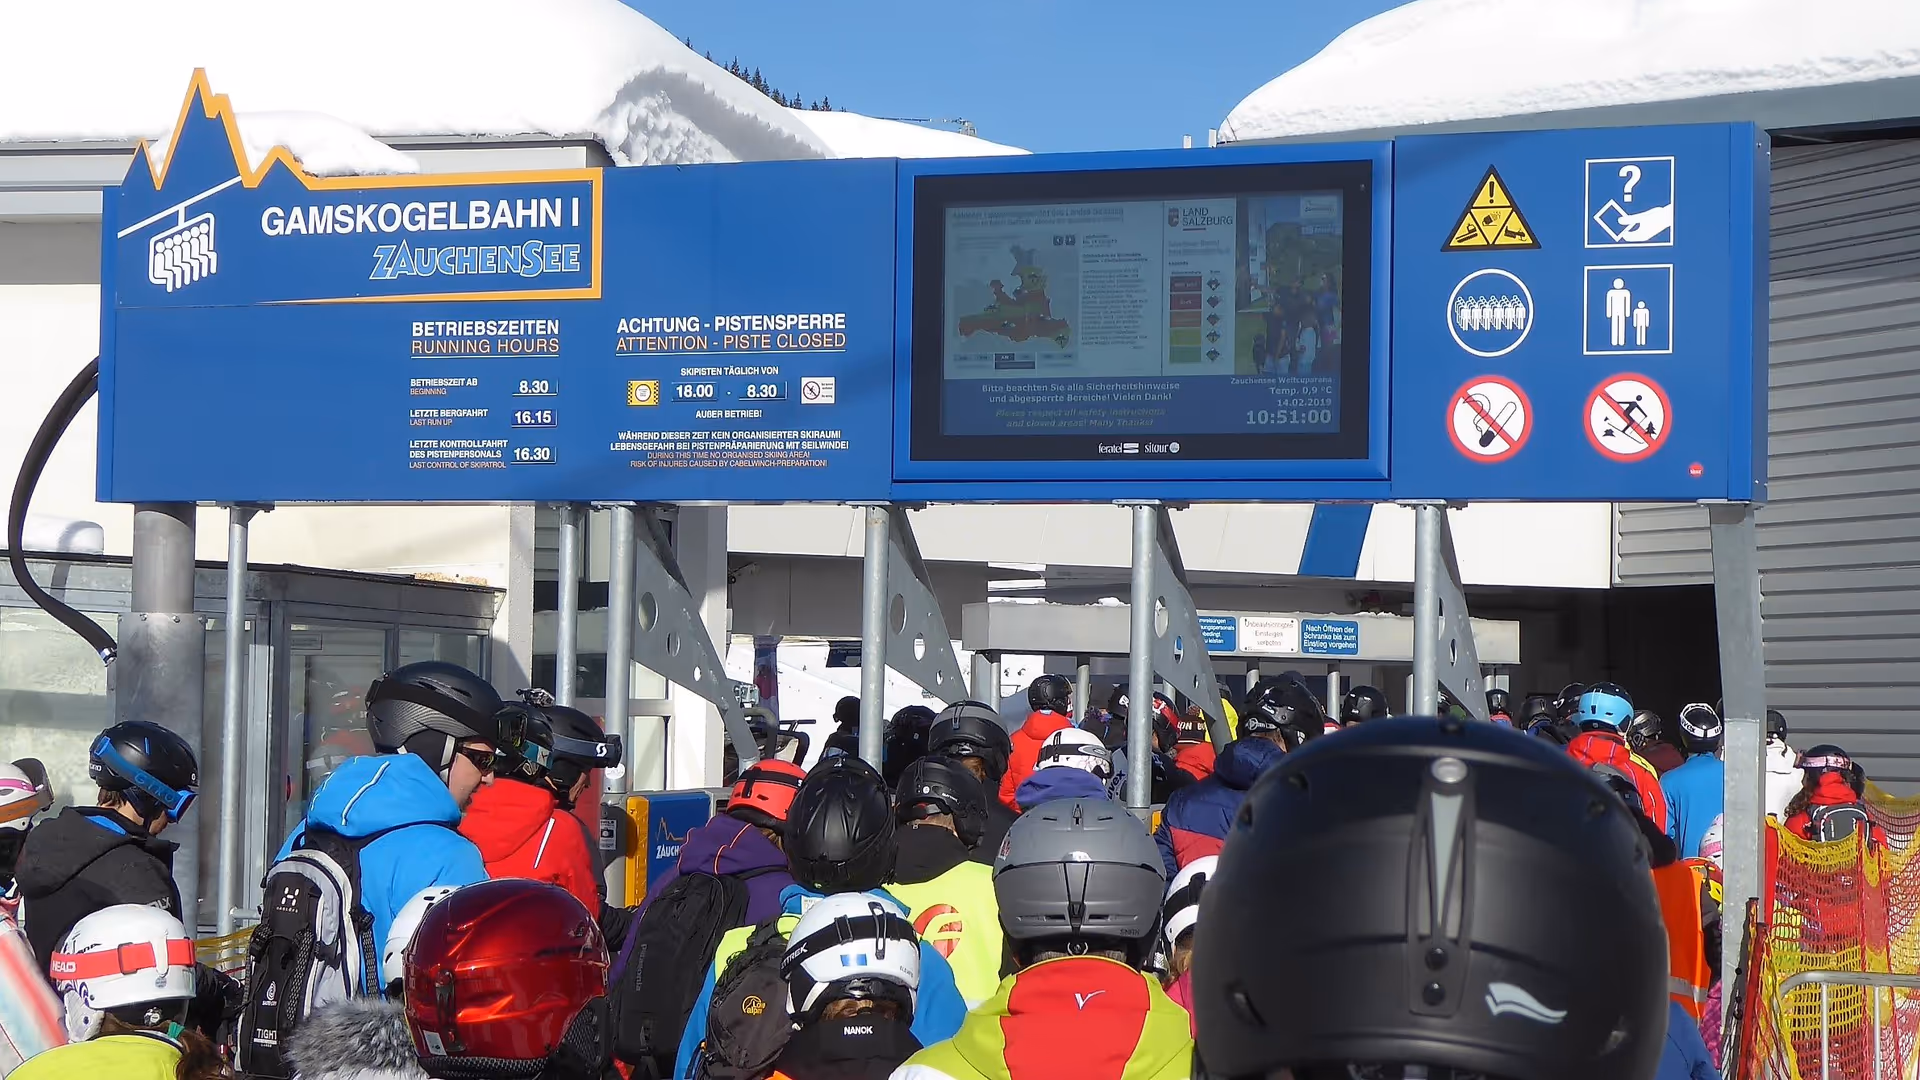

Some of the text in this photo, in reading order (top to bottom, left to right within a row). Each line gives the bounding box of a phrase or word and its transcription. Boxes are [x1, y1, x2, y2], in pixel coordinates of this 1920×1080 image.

[261, 197, 579, 236] GAMSKOGELBAHN I
[1182, 207, 1209, 217] LAND
[1182, 215, 1233, 226] SALZBURG
[412, 319, 559, 337] BETRIEBSZEITEN
[616, 317, 700, 333] ACHTUNG
[714, 313, 846, 332] PISTENSPERRE
[411, 338, 560, 354] RUNNING HOURS
[616, 335, 708, 351] ATTENTION
[723, 334, 771, 349] PISTE
[776, 333, 846, 348] CLOSED
[680, 366, 779, 376] SKIPISTEN TÄGLICH VON
[410, 378, 478, 387] BETRIEBSZEIT AB
[519, 380, 549, 393] 8.30
[1230, 377, 1276, 385] Zauchensee
[675, 385, 714, 398] 18.00
[746, 384, 778, 398] 8.30
[982, 382, 1180, 392] Bitte beachten Sie alle Sicherheitshinweise
[1270, 387, 1299, 396] Temp.
[1302, 387, 1318, 396] 0,9
[989, 395, 1006, 403] und
[1008, 394, 1064, 404] abgesperrte
[1112, 393, 1142, 401] Vielen
[1144, 392, 1172, 401] Dank!
[1277, 398, 1332, 407] 14.02.2019
[410, 408, 488, 418] LETZTE BERGFAHRT
[514, 411, 552, 424] 16.15
[724, 409, 762, 419] BETRIEB!
[1246, 409, 1332, 424] 10:51:00
[618, 430, 660, 440] WÄHREND
[661, 431, 691, 440] DIESER
[692, 431, 710, 440] ZEIT
[711, 431, 730, 440] KEIN
[732, 430, 799, 439] ORGANISIERTER
[409, 439, 508, 448] LETZTE KONTROLLFAHRT
[610, 441, 675, 451] LEBENSGEFAHR
[676, 442, 690, 451] BEI
[691, 440, 785, 450] PISTENPRÄPARIERUNG
[786, 441, 800, 450] MIT
[1098, 442, 1123, 454] feratel
[1144, 441, 1169, 454] sitour
[409, 450, 502, 459] DES PISTENPERSONALS
[513, 447, 550, 461] 16.30
[722, 451, 763, 459] ORGANISED
[764, 451, 788, 459] SKIING
[409, 461, 426, 469] LAST
[426, 461, 459, 469] CONTROL
[460, 461, 470, 469] OF
[1305, 624, 1321, 632] Nach
[1322, 624, 1343, 633] Öffnen
[1303, 632, 1332, 640] Schranke
[1303, 640, 1357, 649] Einstieg vorgehen
[1107, 769, 1126, 800] uvex
[656, 844, 680, 859] ZAUCH
[51, 959, 77, 973] HEAD
[256, 1028, 277, 1040] TIGHT
[843, 1025, 874, 1035] NANOK
